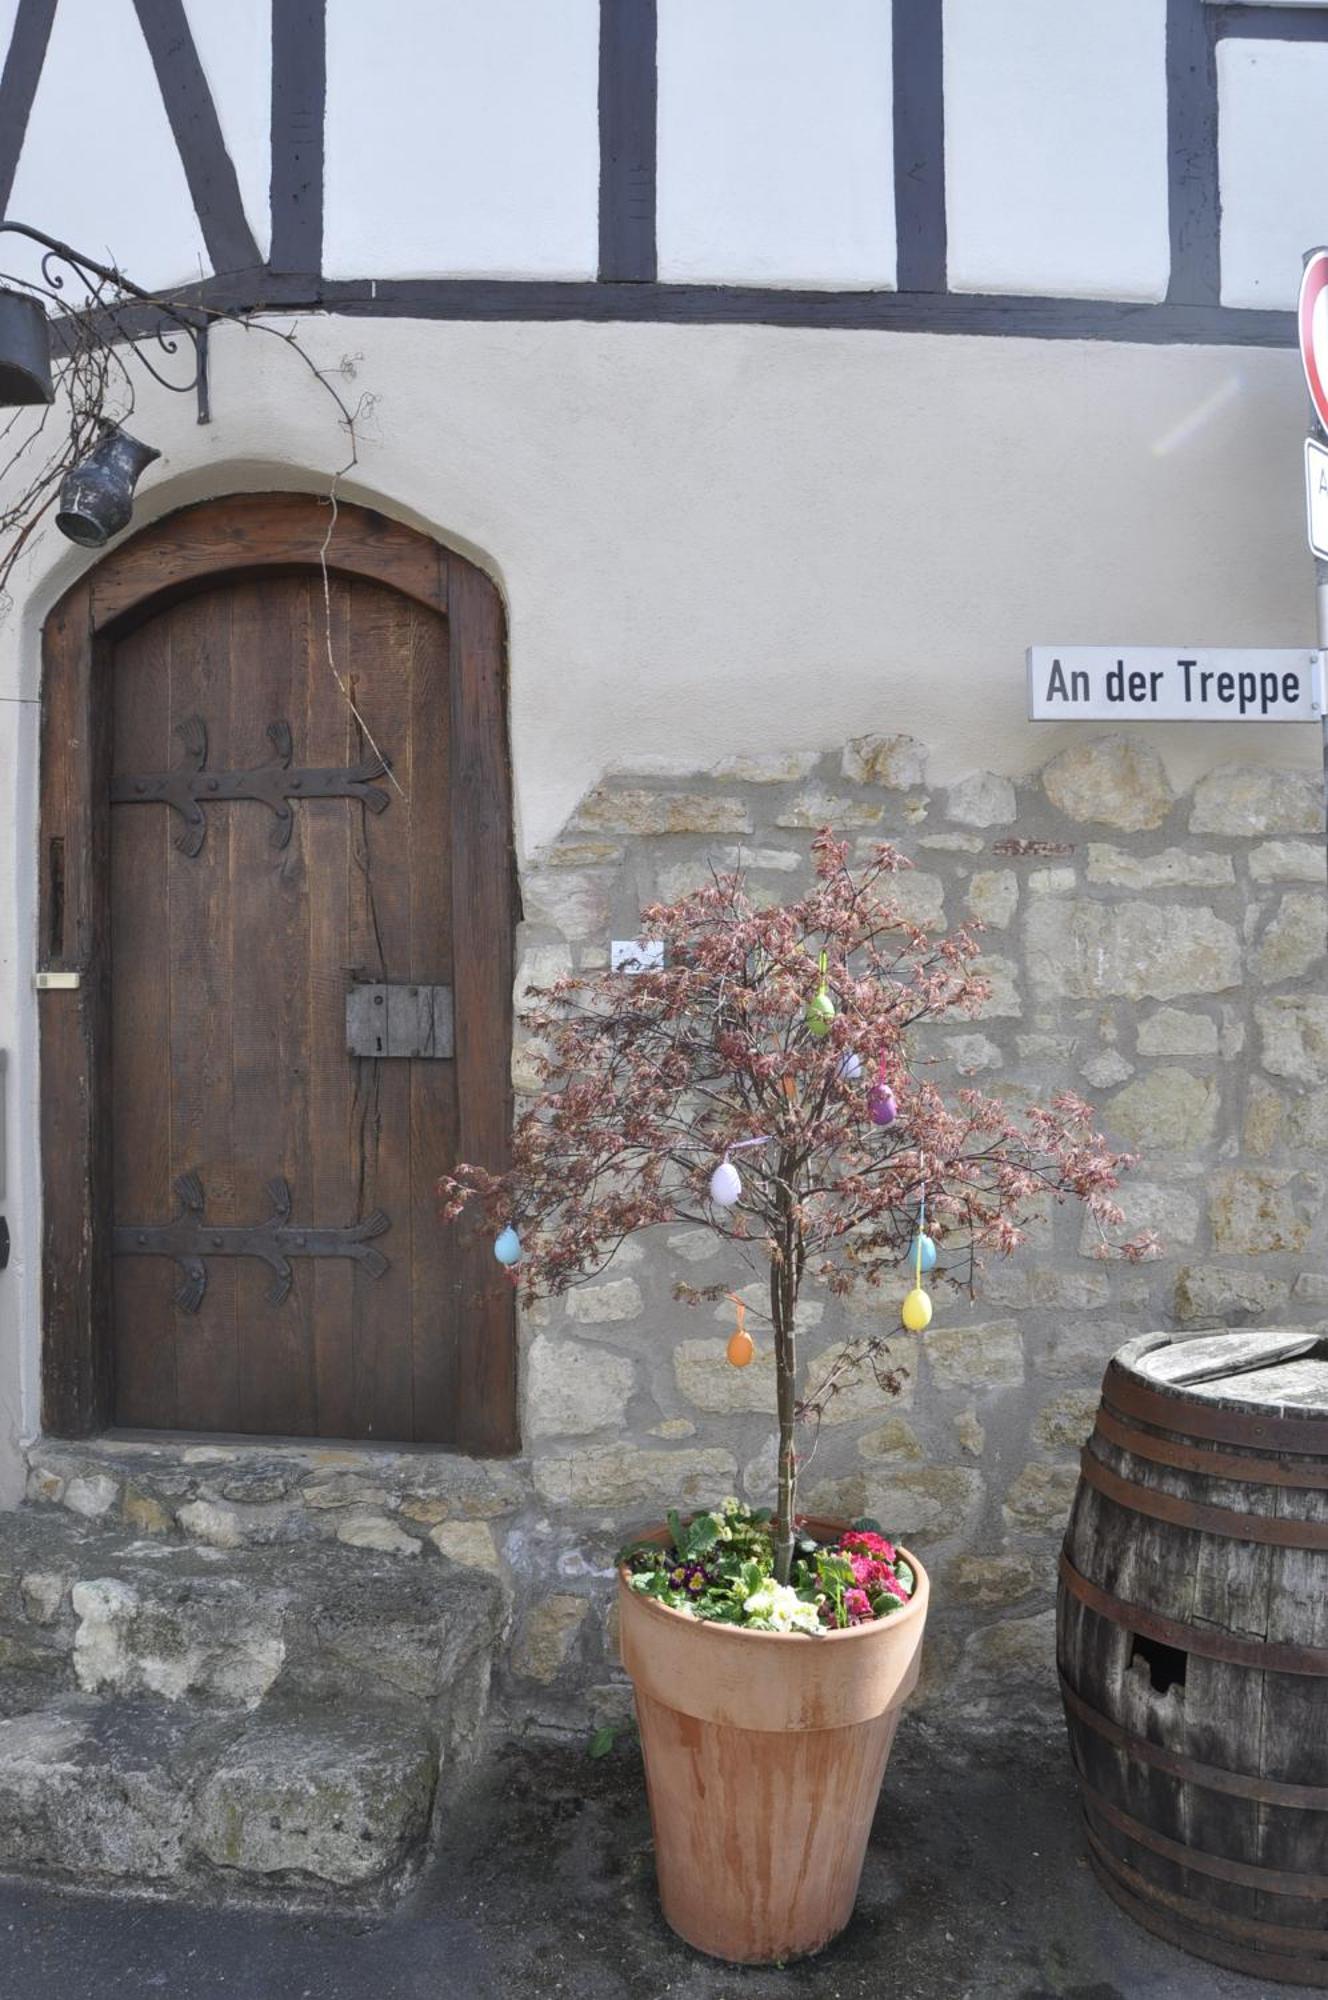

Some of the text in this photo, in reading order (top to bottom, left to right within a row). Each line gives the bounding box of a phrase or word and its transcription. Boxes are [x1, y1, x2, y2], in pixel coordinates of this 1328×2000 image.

[1046, 659, 1300, 714] An der Treppe
